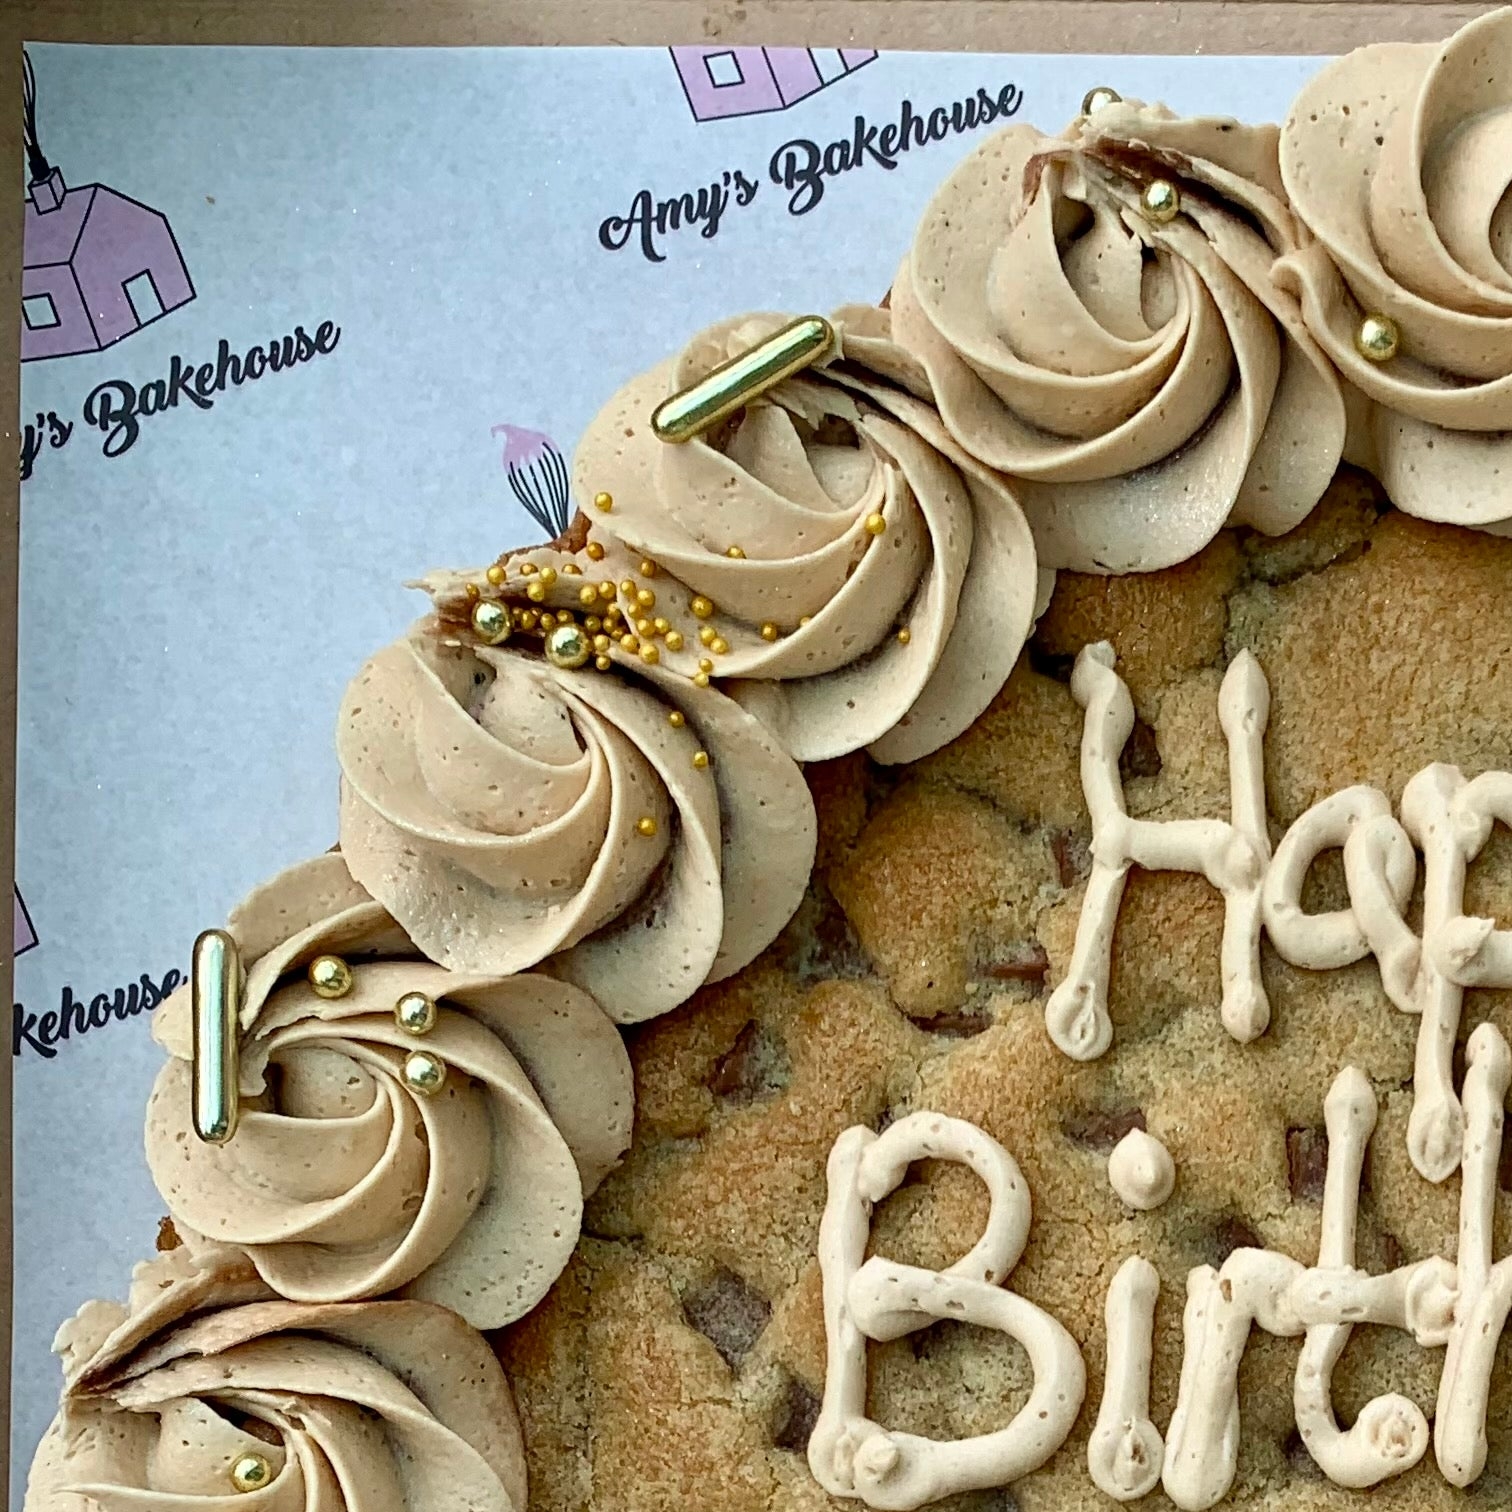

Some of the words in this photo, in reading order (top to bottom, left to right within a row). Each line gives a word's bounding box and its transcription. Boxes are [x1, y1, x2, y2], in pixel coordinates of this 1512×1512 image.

[599, 165, 758, 262] Amy's
[770, 81, 1023, 214] Bakehouse
[83, 320, 341, 457] Bakehouse
